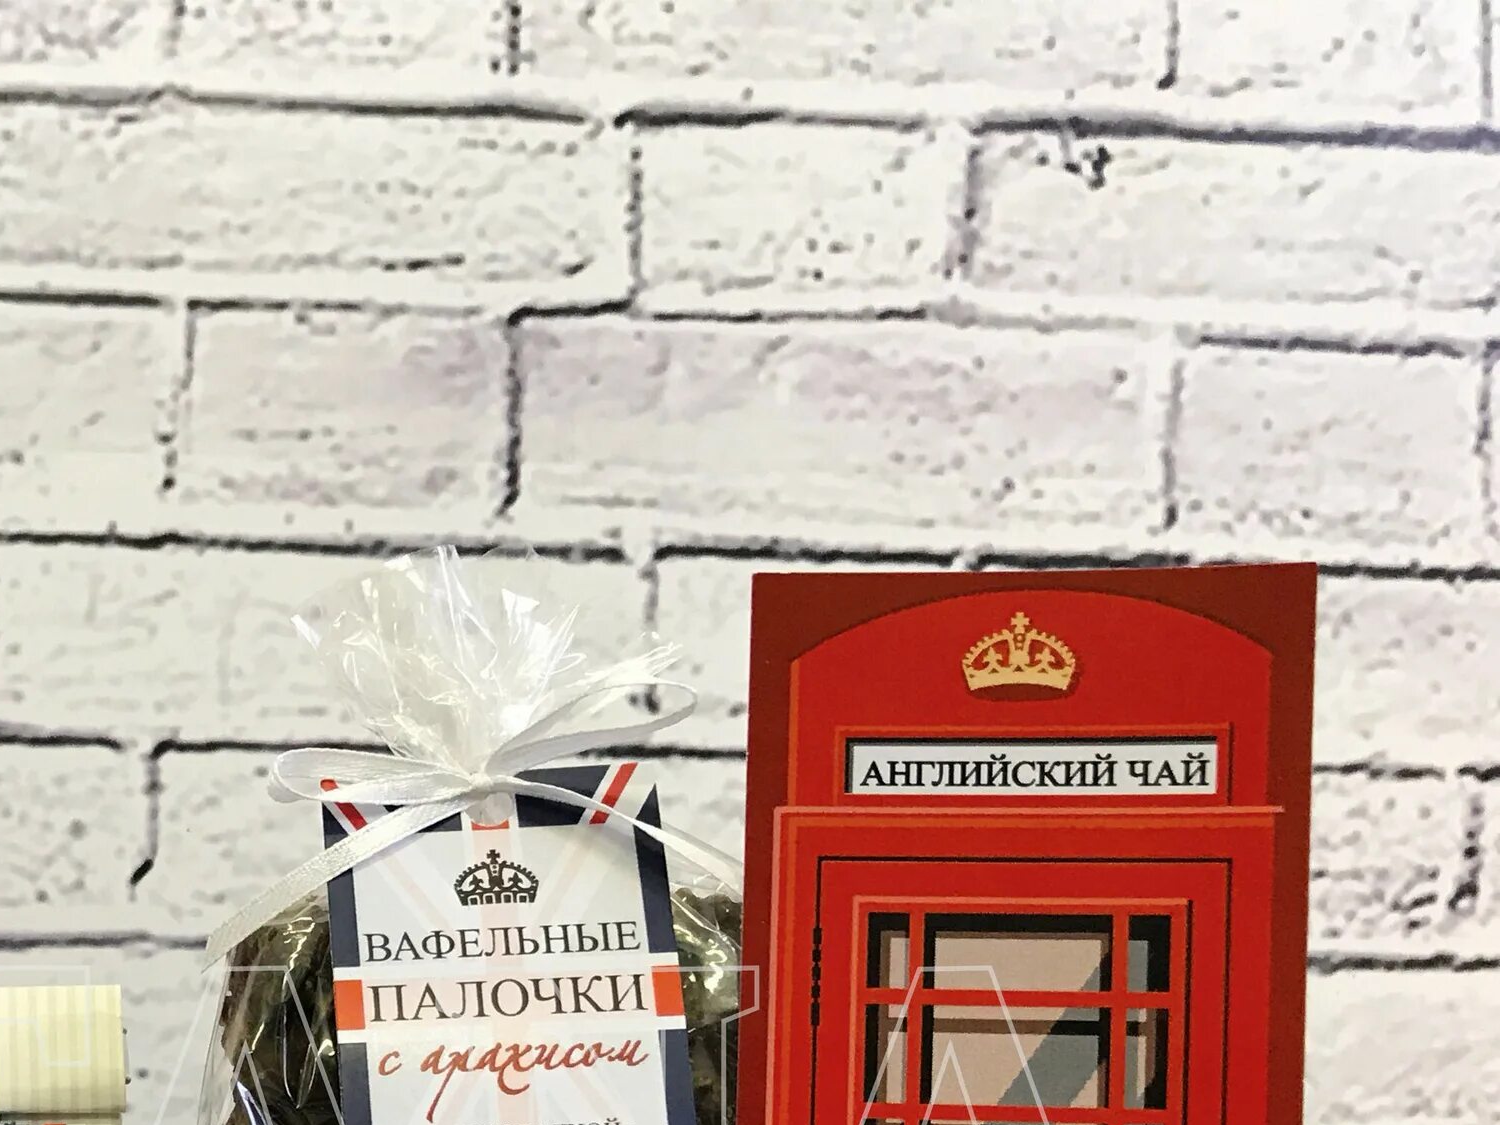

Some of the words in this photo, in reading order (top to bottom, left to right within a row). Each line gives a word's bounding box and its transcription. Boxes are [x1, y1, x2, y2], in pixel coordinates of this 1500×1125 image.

[859, 753, 1119, 787] АНГЛИЙСКИЙ
[1126, 752, 1211, 786] ЧАЙ
[364, 920, 642, 962] ВАФЕЛЬНЫЕ
[369, 974, 648, 1022] ПАЛОЧКИ
[378, 1050, 403, 1077] с
[419, 1039, 650, 1123] арахисом
